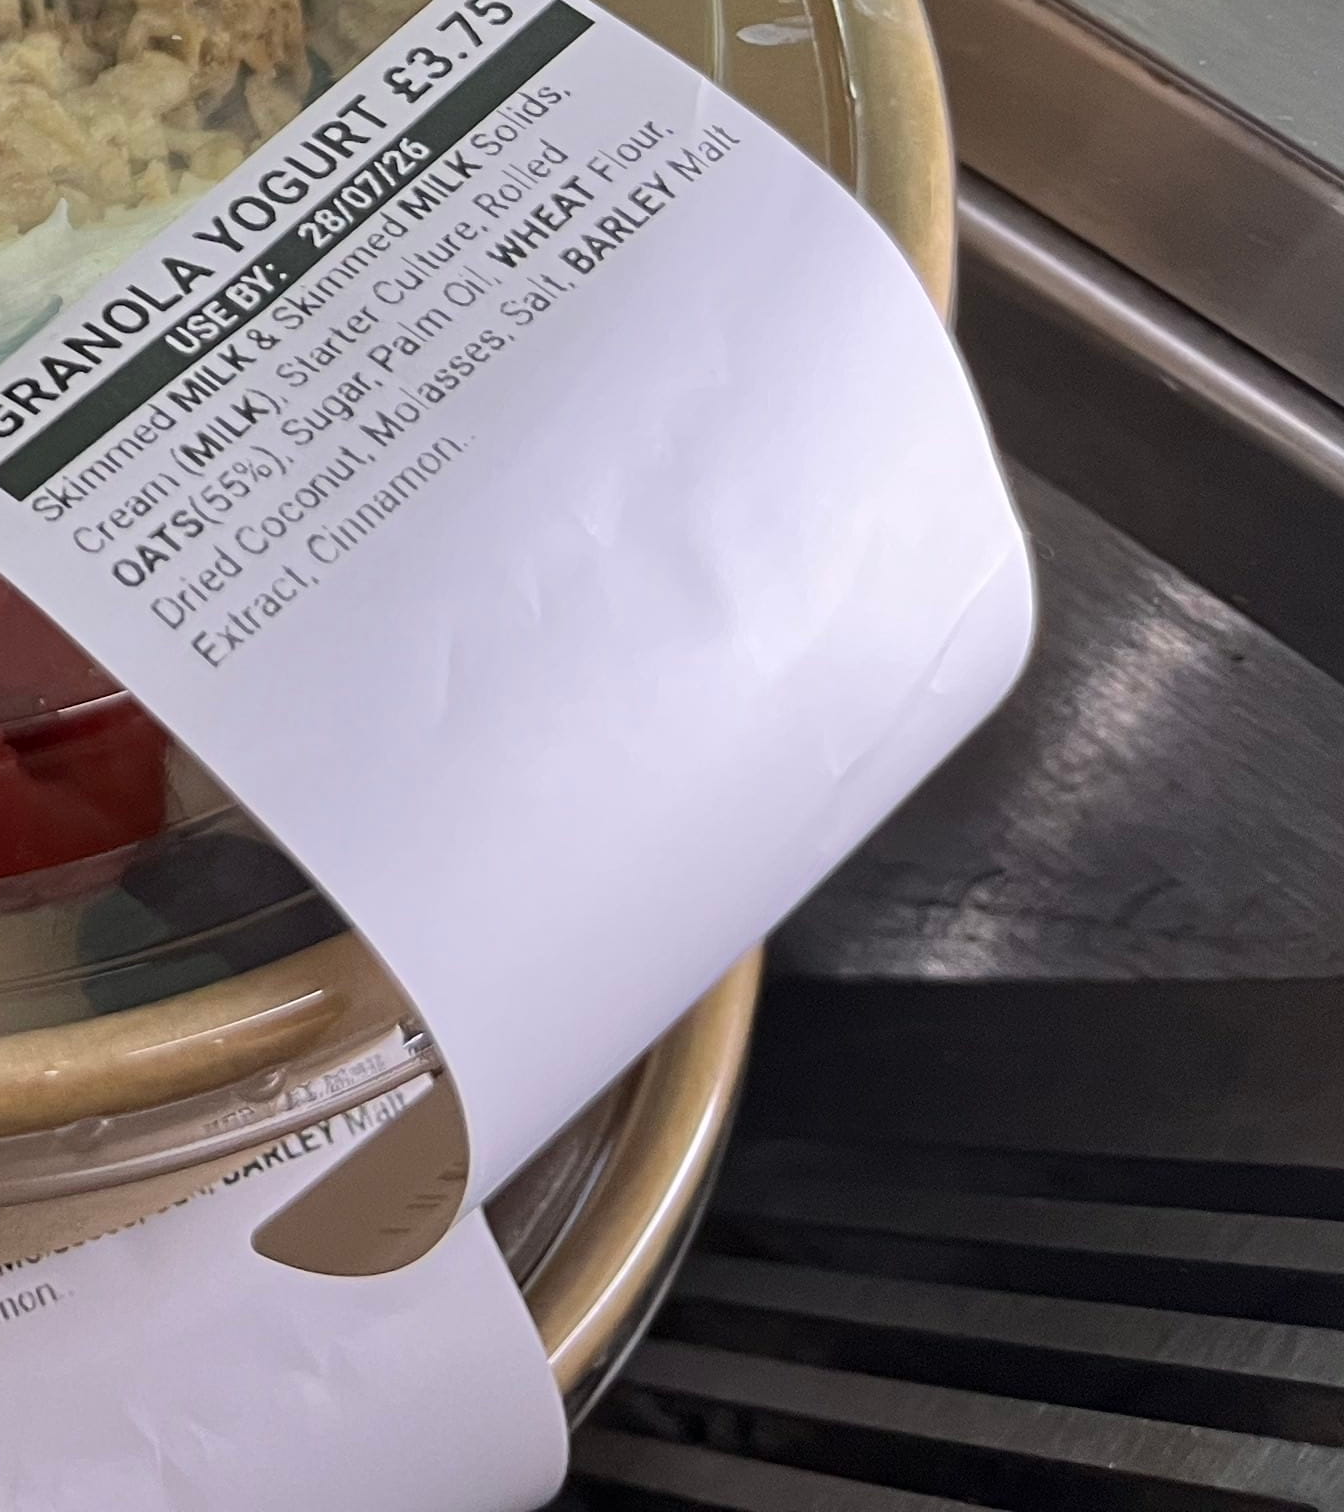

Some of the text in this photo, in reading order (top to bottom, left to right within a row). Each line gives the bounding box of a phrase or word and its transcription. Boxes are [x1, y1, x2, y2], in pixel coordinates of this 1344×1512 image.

[32, 87, 571, 521] Skimmed MILK & Skimmed MILK Solids,
[165, 138, 430, 354] USE BY: 28/07/26
[192, 94, 387, 252] YOGURT
[281, 372, 383, 444] Sugar,
[367, 309, 452, 373] Palm
[443, 266, 502, 306] Oil,
[486, 176, 594, 268] WHEAT
[587, 121, 674, 183] Flour,
[74, 139, 568, 553] Cream (MILK), Starter Culture, Rolled
[151, 125, 740, 630] Dried Coconut, Molasses, Salt, BARLEY Malt
[191, 566, 319, 668] Extract,
